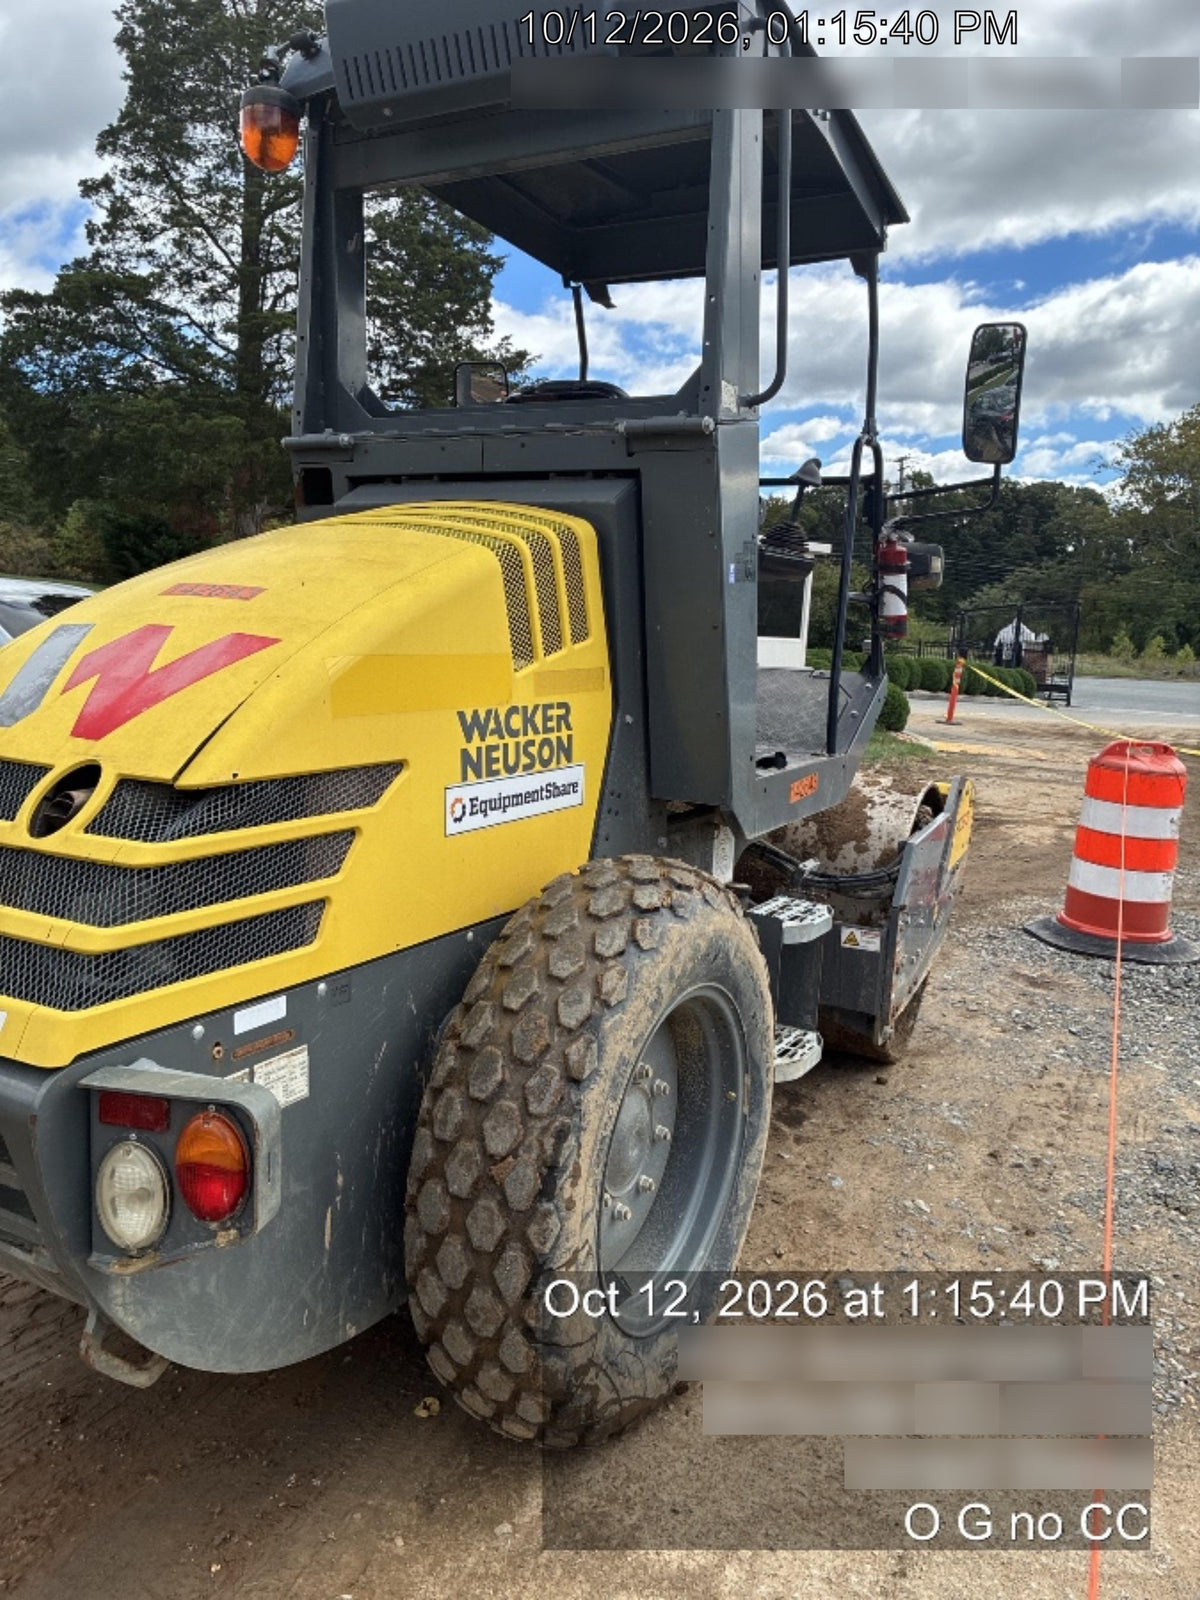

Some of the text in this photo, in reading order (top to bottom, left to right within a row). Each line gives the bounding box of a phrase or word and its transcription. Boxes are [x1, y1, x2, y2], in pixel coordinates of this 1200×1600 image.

[456, 701, 573, 744] WACKER
[460, 733, 573, 783] NEUSON
[468, 781, 579, 818] EquipmentShare
